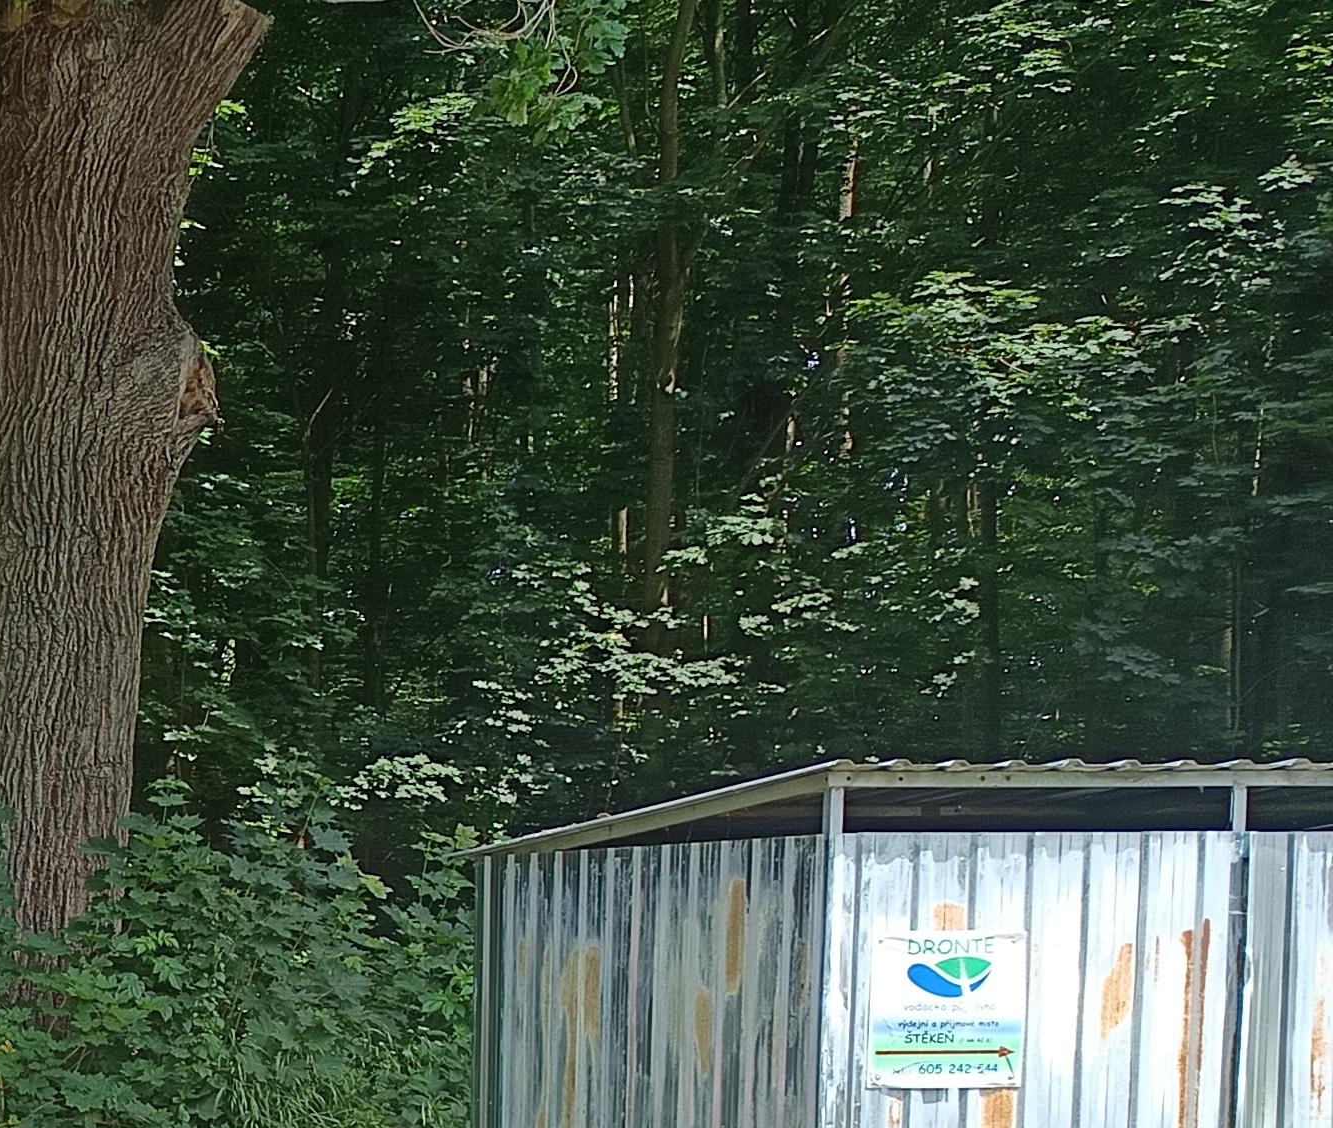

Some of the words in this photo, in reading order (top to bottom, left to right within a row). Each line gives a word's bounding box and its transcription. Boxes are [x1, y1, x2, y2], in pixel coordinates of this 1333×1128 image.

[907, 937, 995, 955] DRONTE
[904, 1030, 954, 1043] ŠTĚKEŇ
[919, 1064, 943, 1074] 605
[949, 1064, 972, 1074] 242
